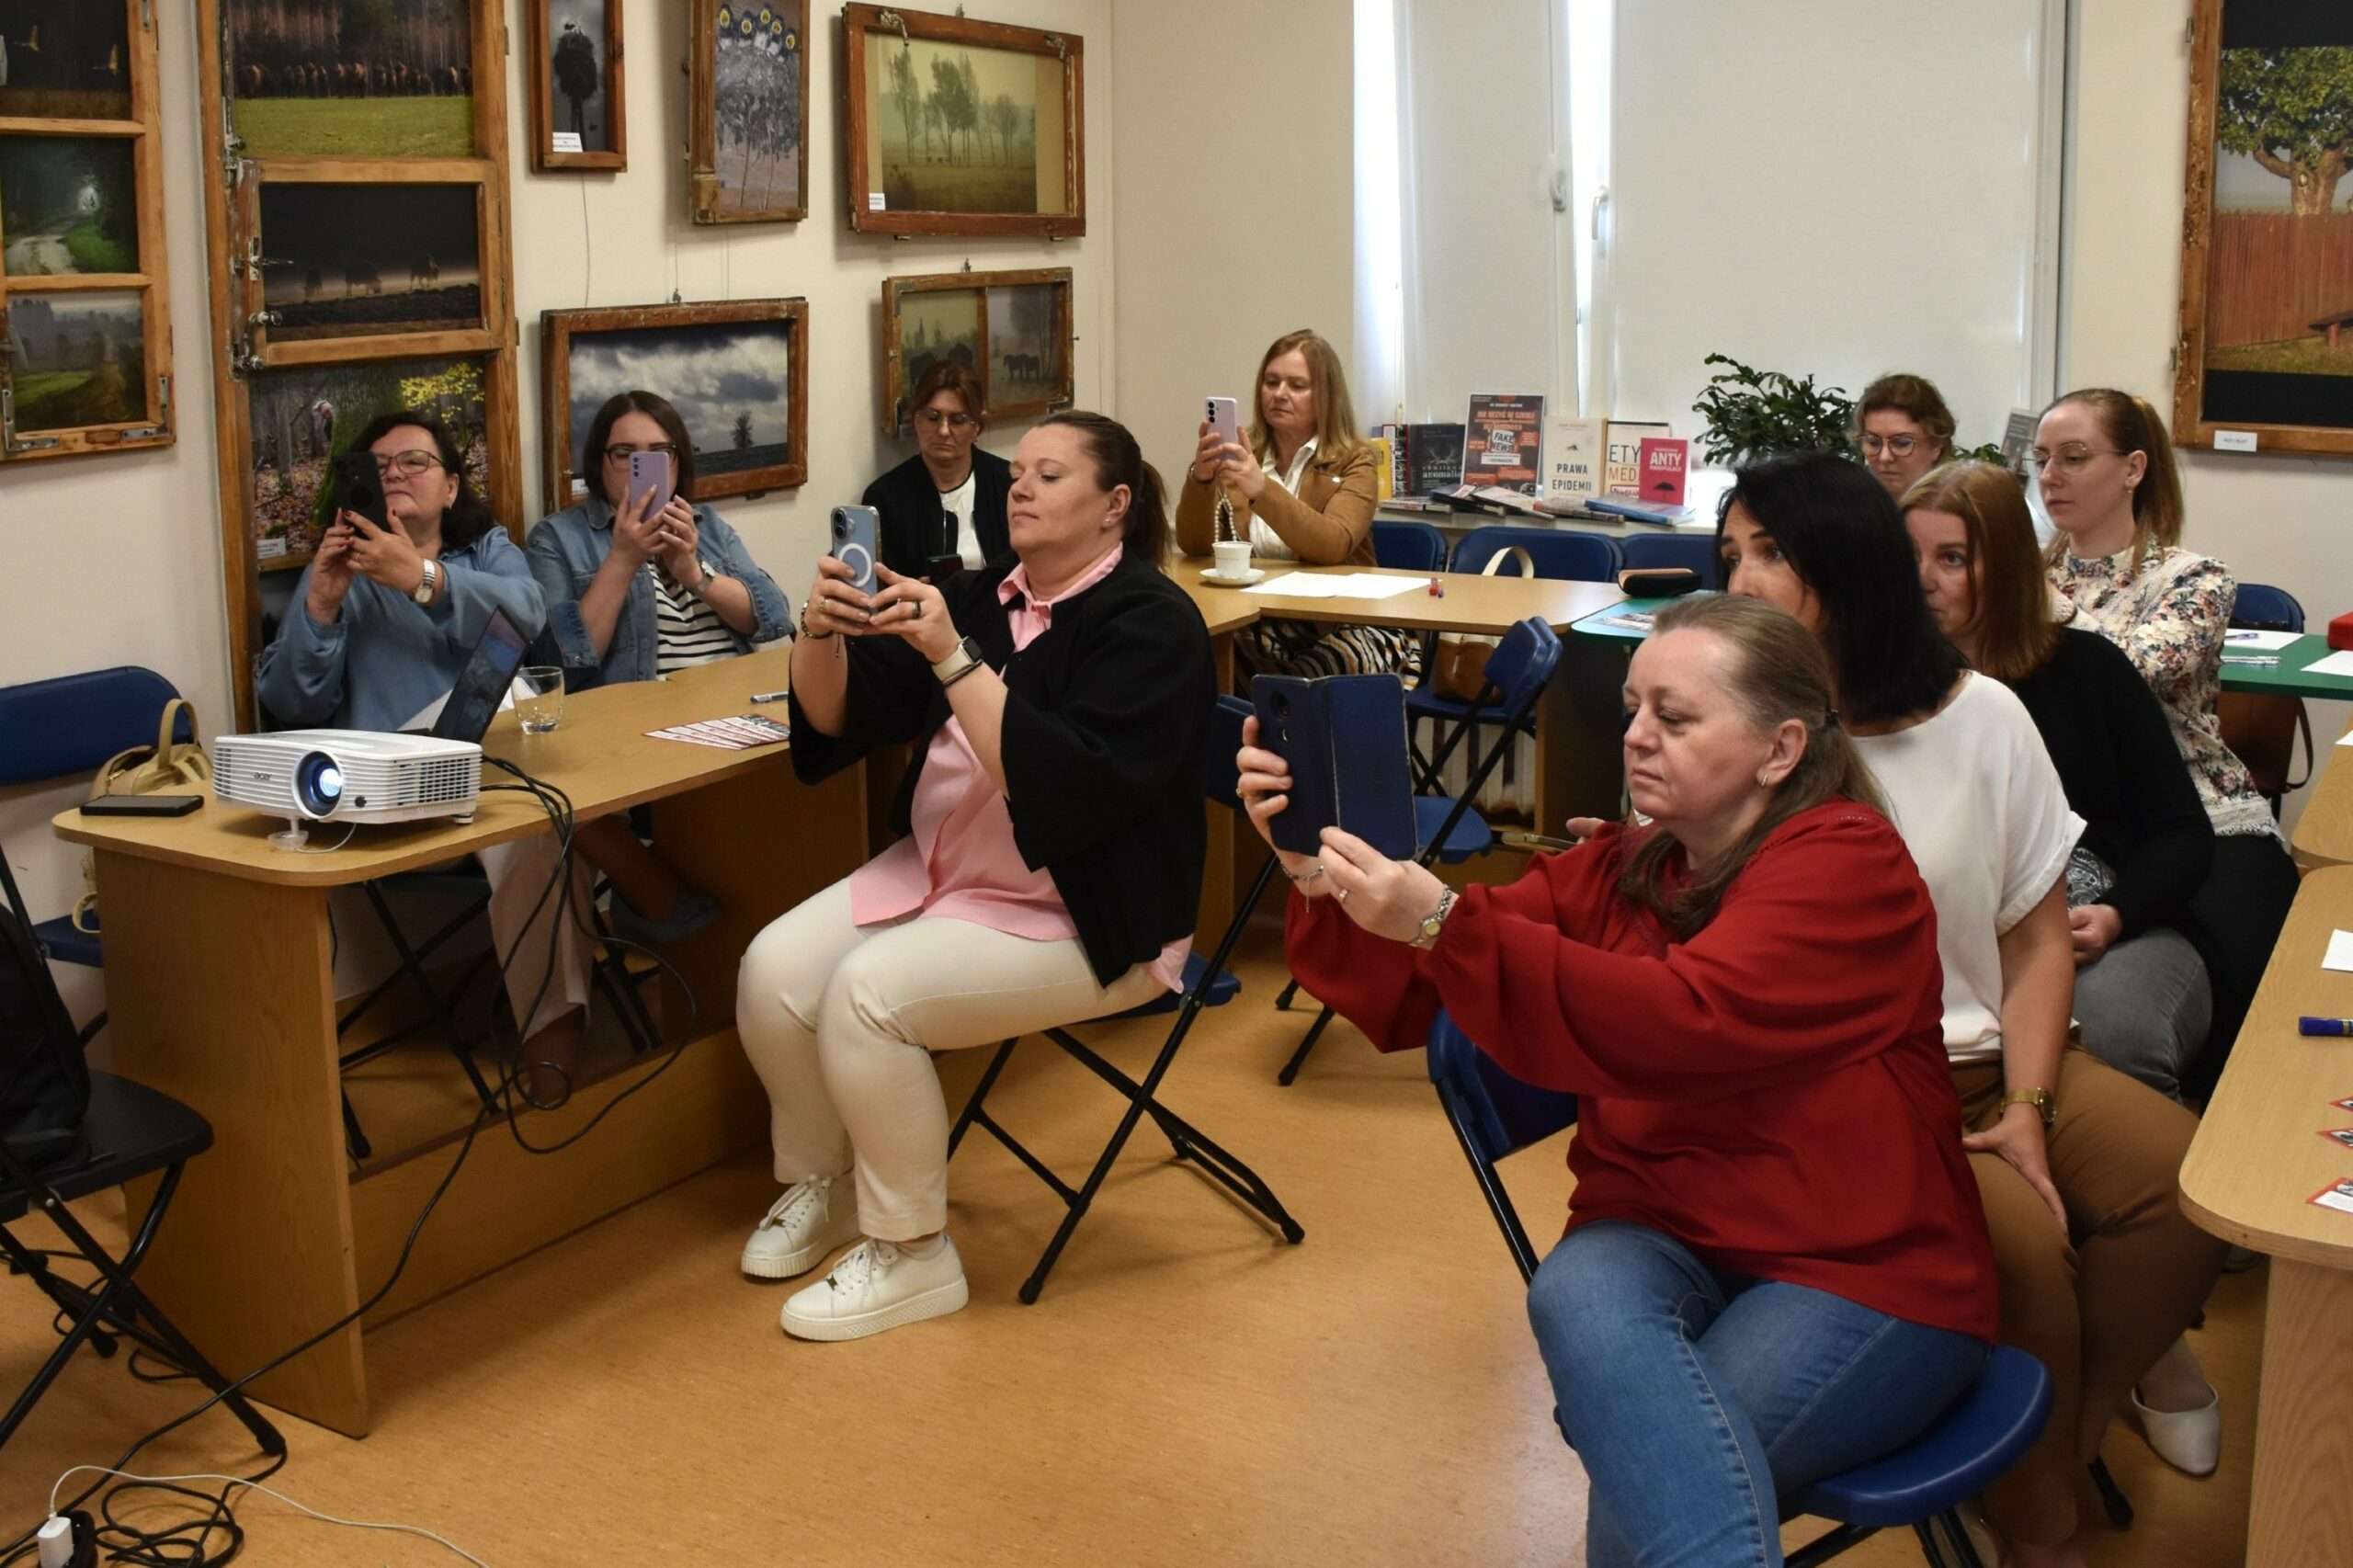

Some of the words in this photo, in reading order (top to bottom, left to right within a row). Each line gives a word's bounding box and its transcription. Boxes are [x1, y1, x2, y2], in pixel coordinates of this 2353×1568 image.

[1494, 432, 1515, 444] FAKE
[1650, 452, 1681, 467] ANTY
[1557, 463, 1587, 474] PRAWA
[1552, 479, 1591, 492] EPIDEMII
